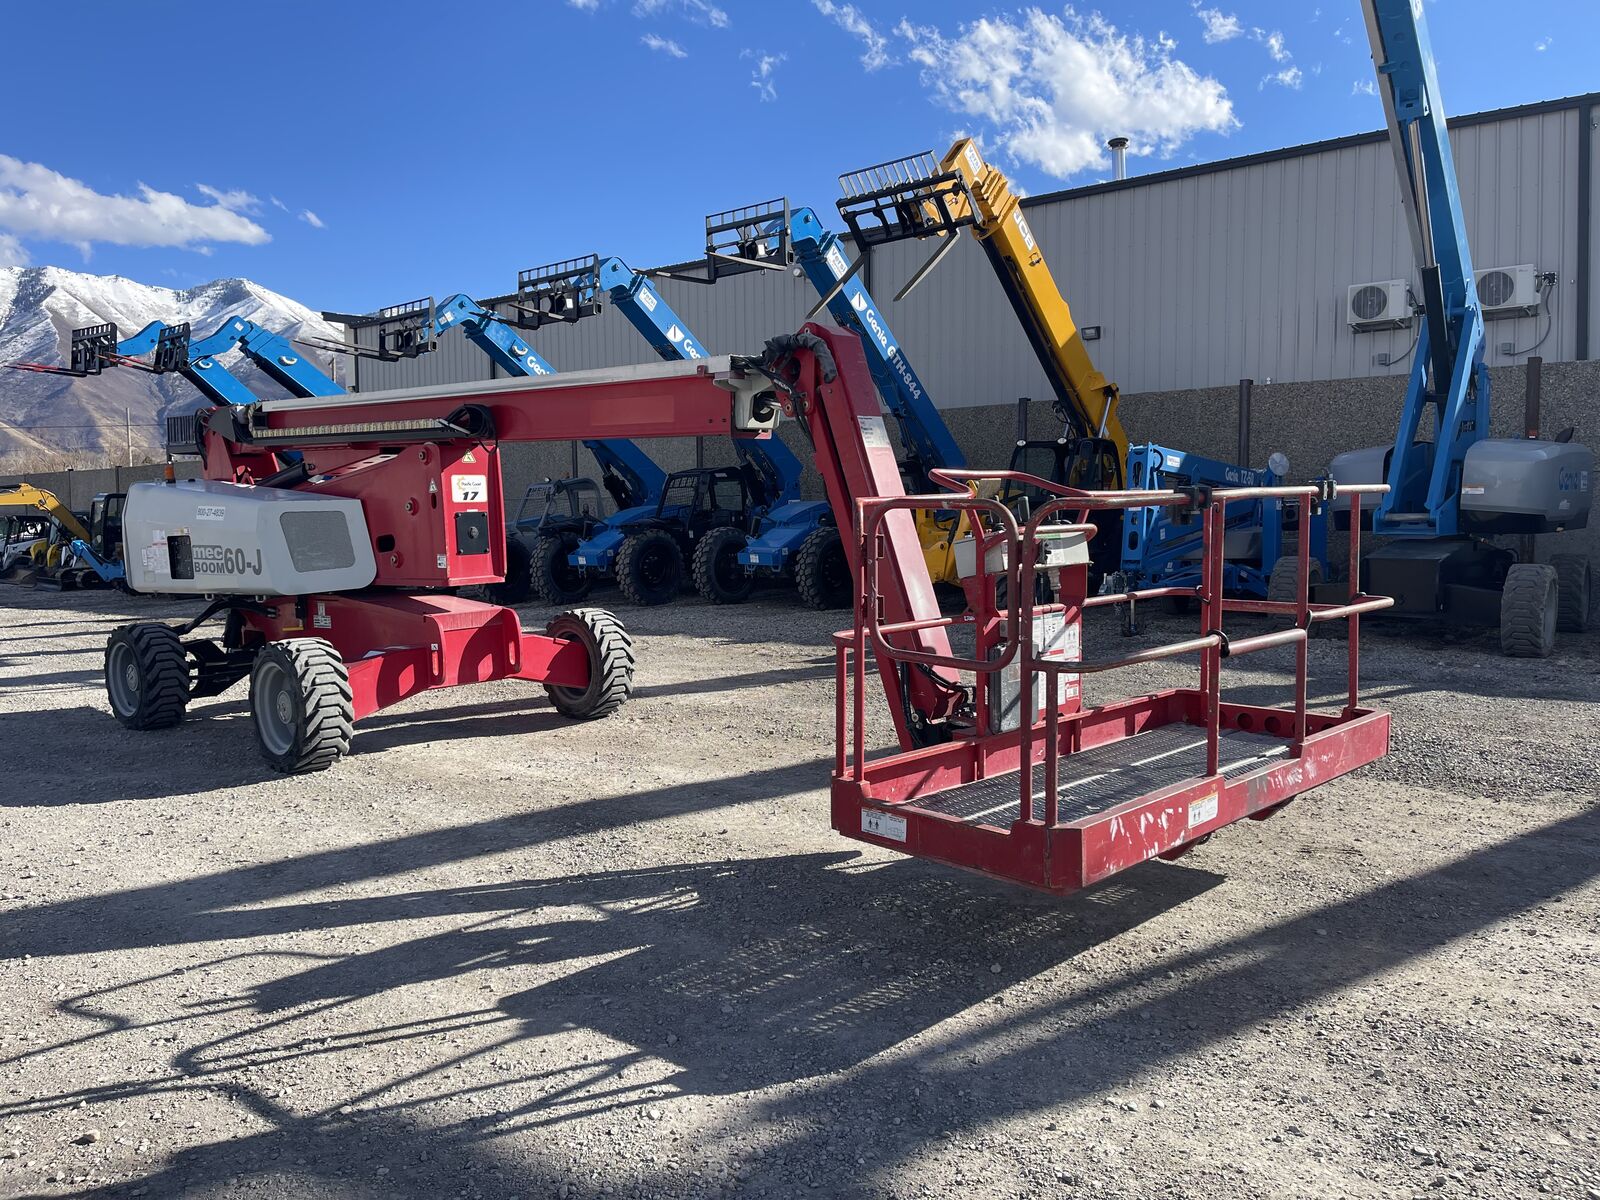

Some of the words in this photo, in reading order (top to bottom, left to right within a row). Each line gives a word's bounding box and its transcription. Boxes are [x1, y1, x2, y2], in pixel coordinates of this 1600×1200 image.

[1014, 210, 1034, 251] JCB
[866, 310, 888, 348] Genie
[887, 346, 921, 399] GTH-844
[463, 491, 479, 501] 17
[193, 547, 223, 559] mec
[194, 562, 225, 574] BOOM
[224, 548, 262, 575] 60-J
